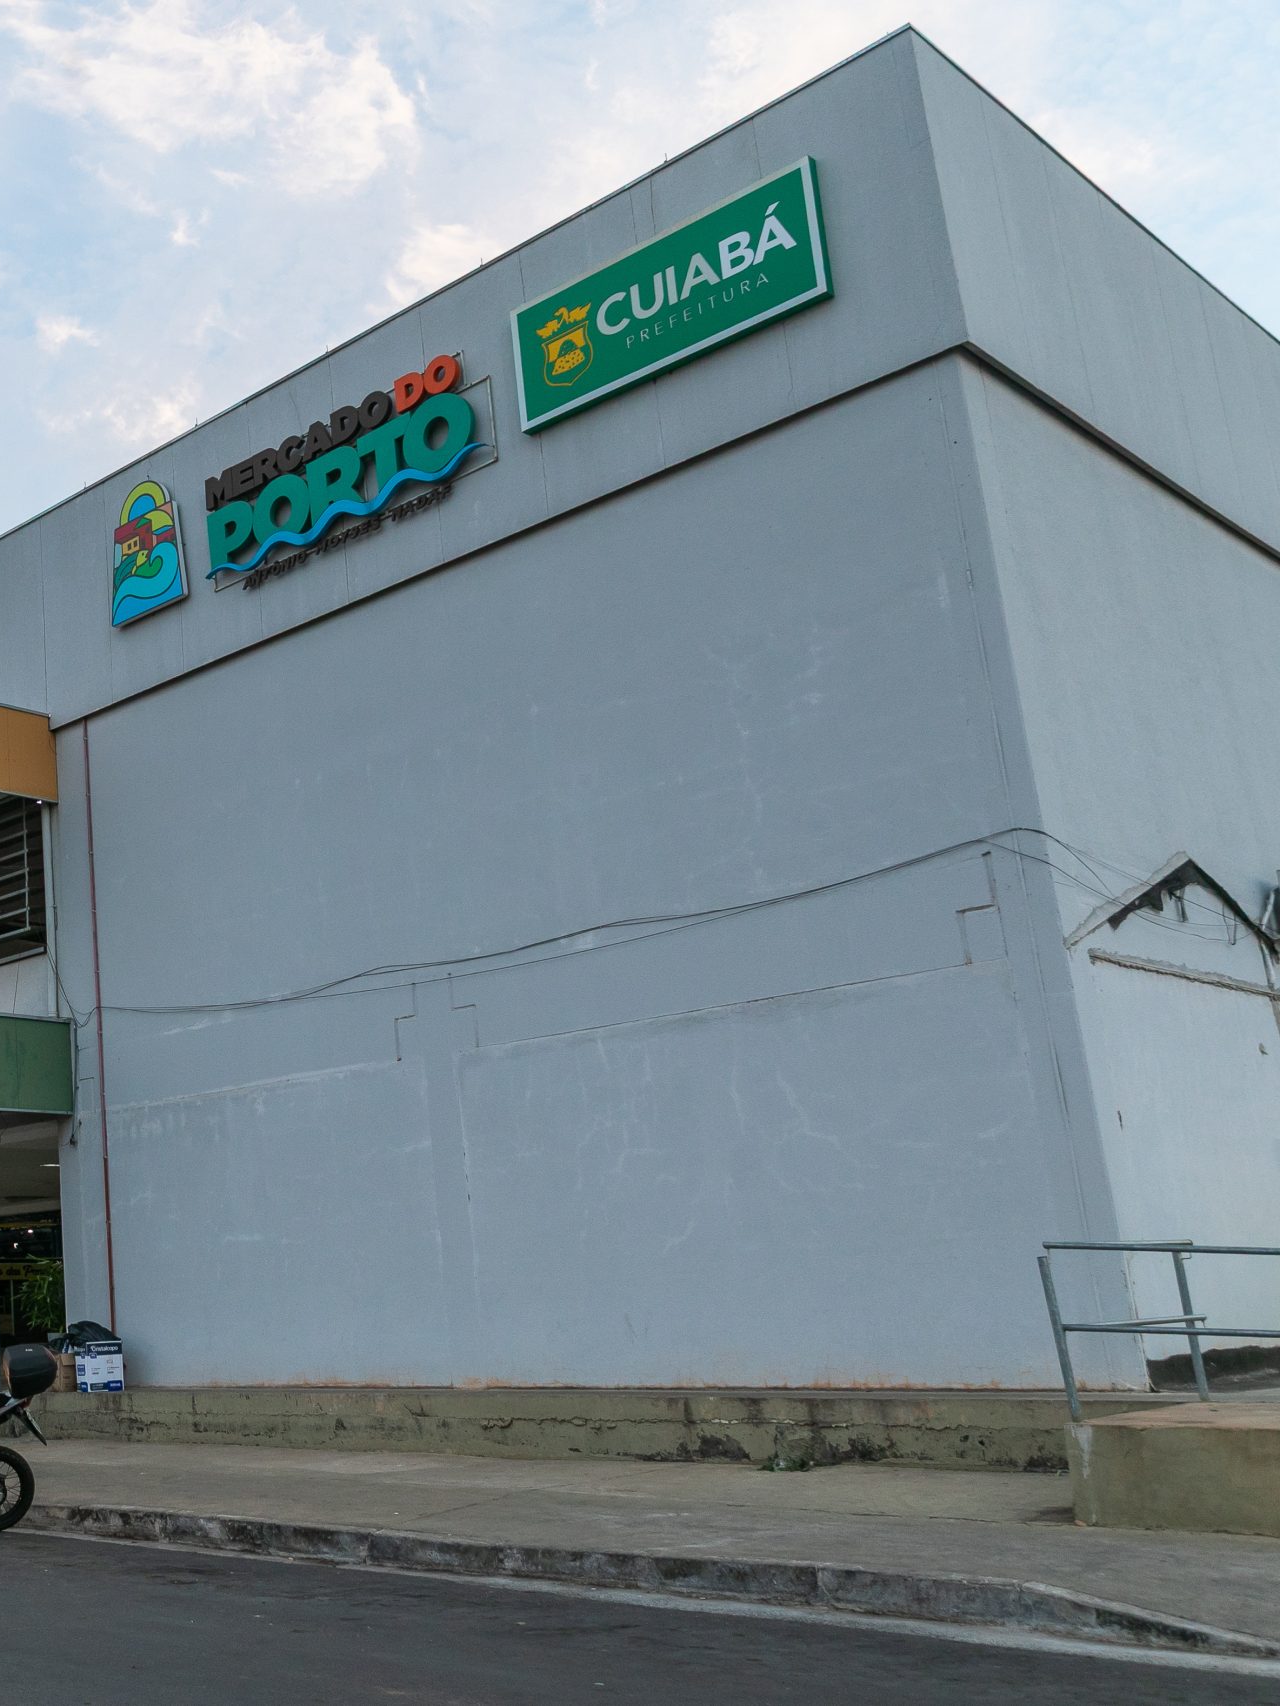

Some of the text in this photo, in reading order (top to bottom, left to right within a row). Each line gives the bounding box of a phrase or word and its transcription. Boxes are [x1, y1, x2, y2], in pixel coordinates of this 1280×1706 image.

[596, 200, 797, 336] CUIABÁ
[626, 272, 769, 349] PREFEITURA
[205, 354, 461, 512] MERCADO DO
[207, 392, 476, 572] PORTO
